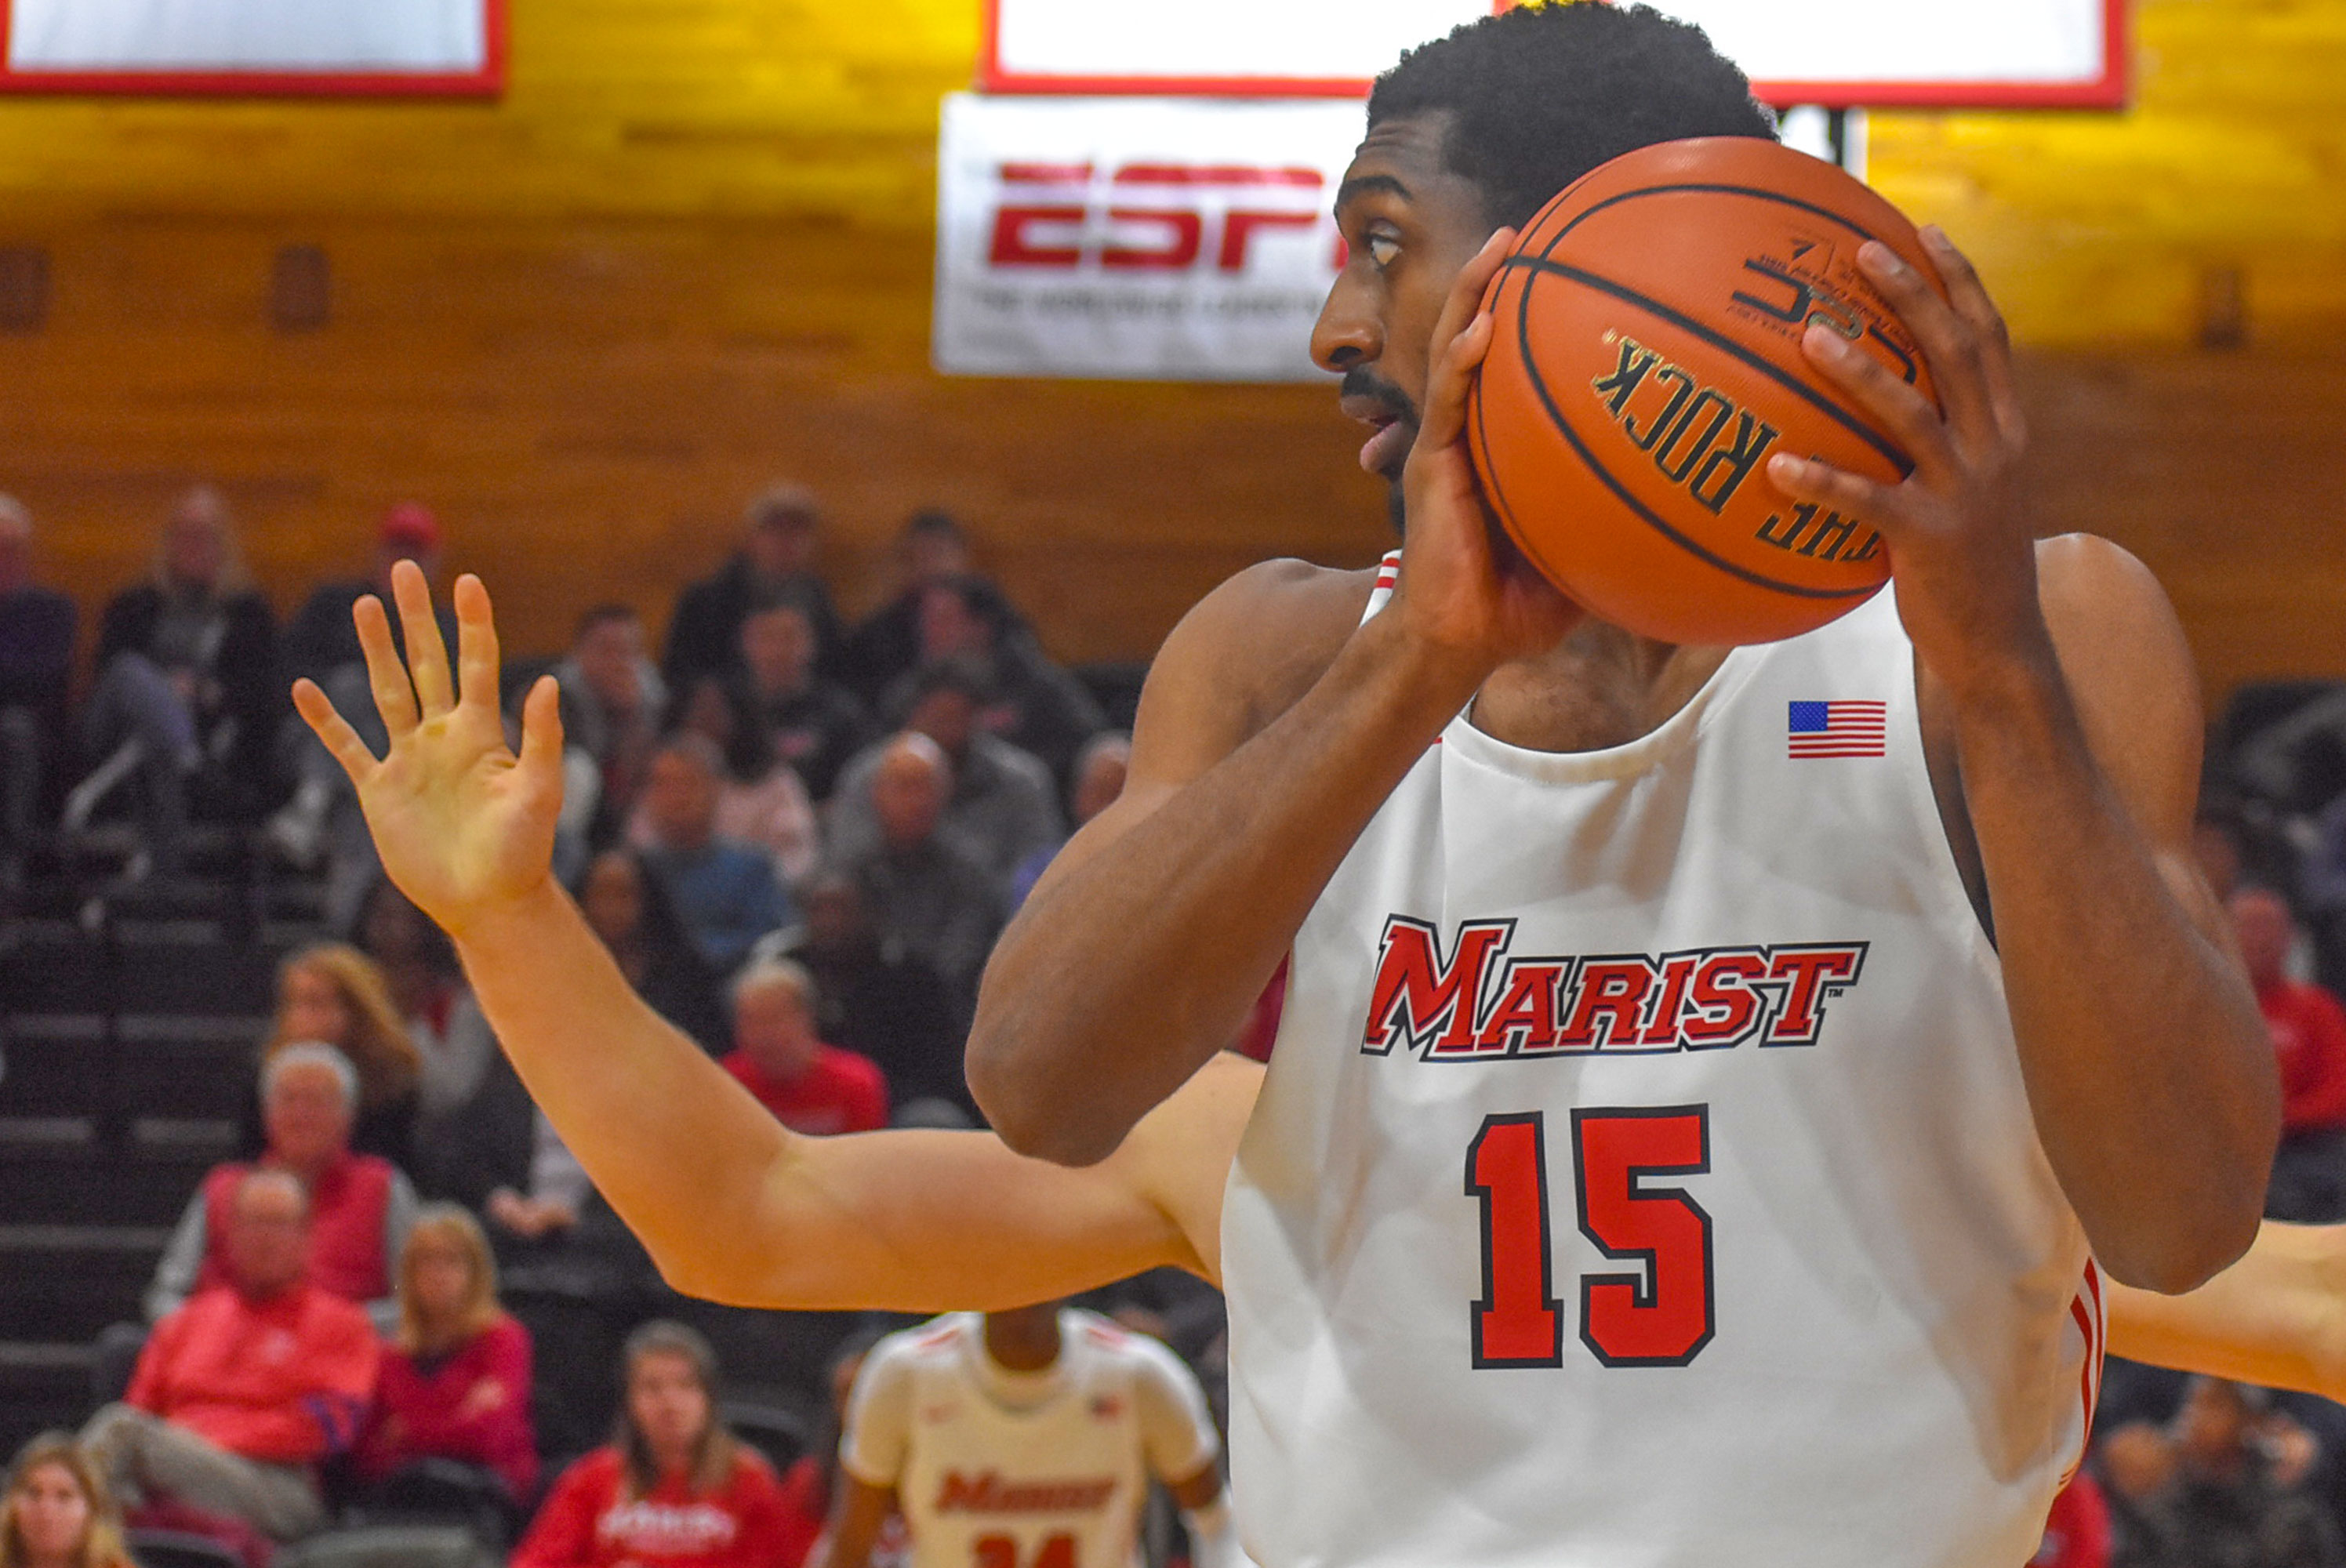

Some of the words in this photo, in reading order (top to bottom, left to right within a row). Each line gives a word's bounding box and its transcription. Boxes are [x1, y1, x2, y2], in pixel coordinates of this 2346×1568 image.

[987, 162, 1348, 273] ESP
[1591, 335, 1781, 517] ROCK
[1360, 913, 1870, 1062] MARIST
[1465, 1103, 1716, 1370] 15
